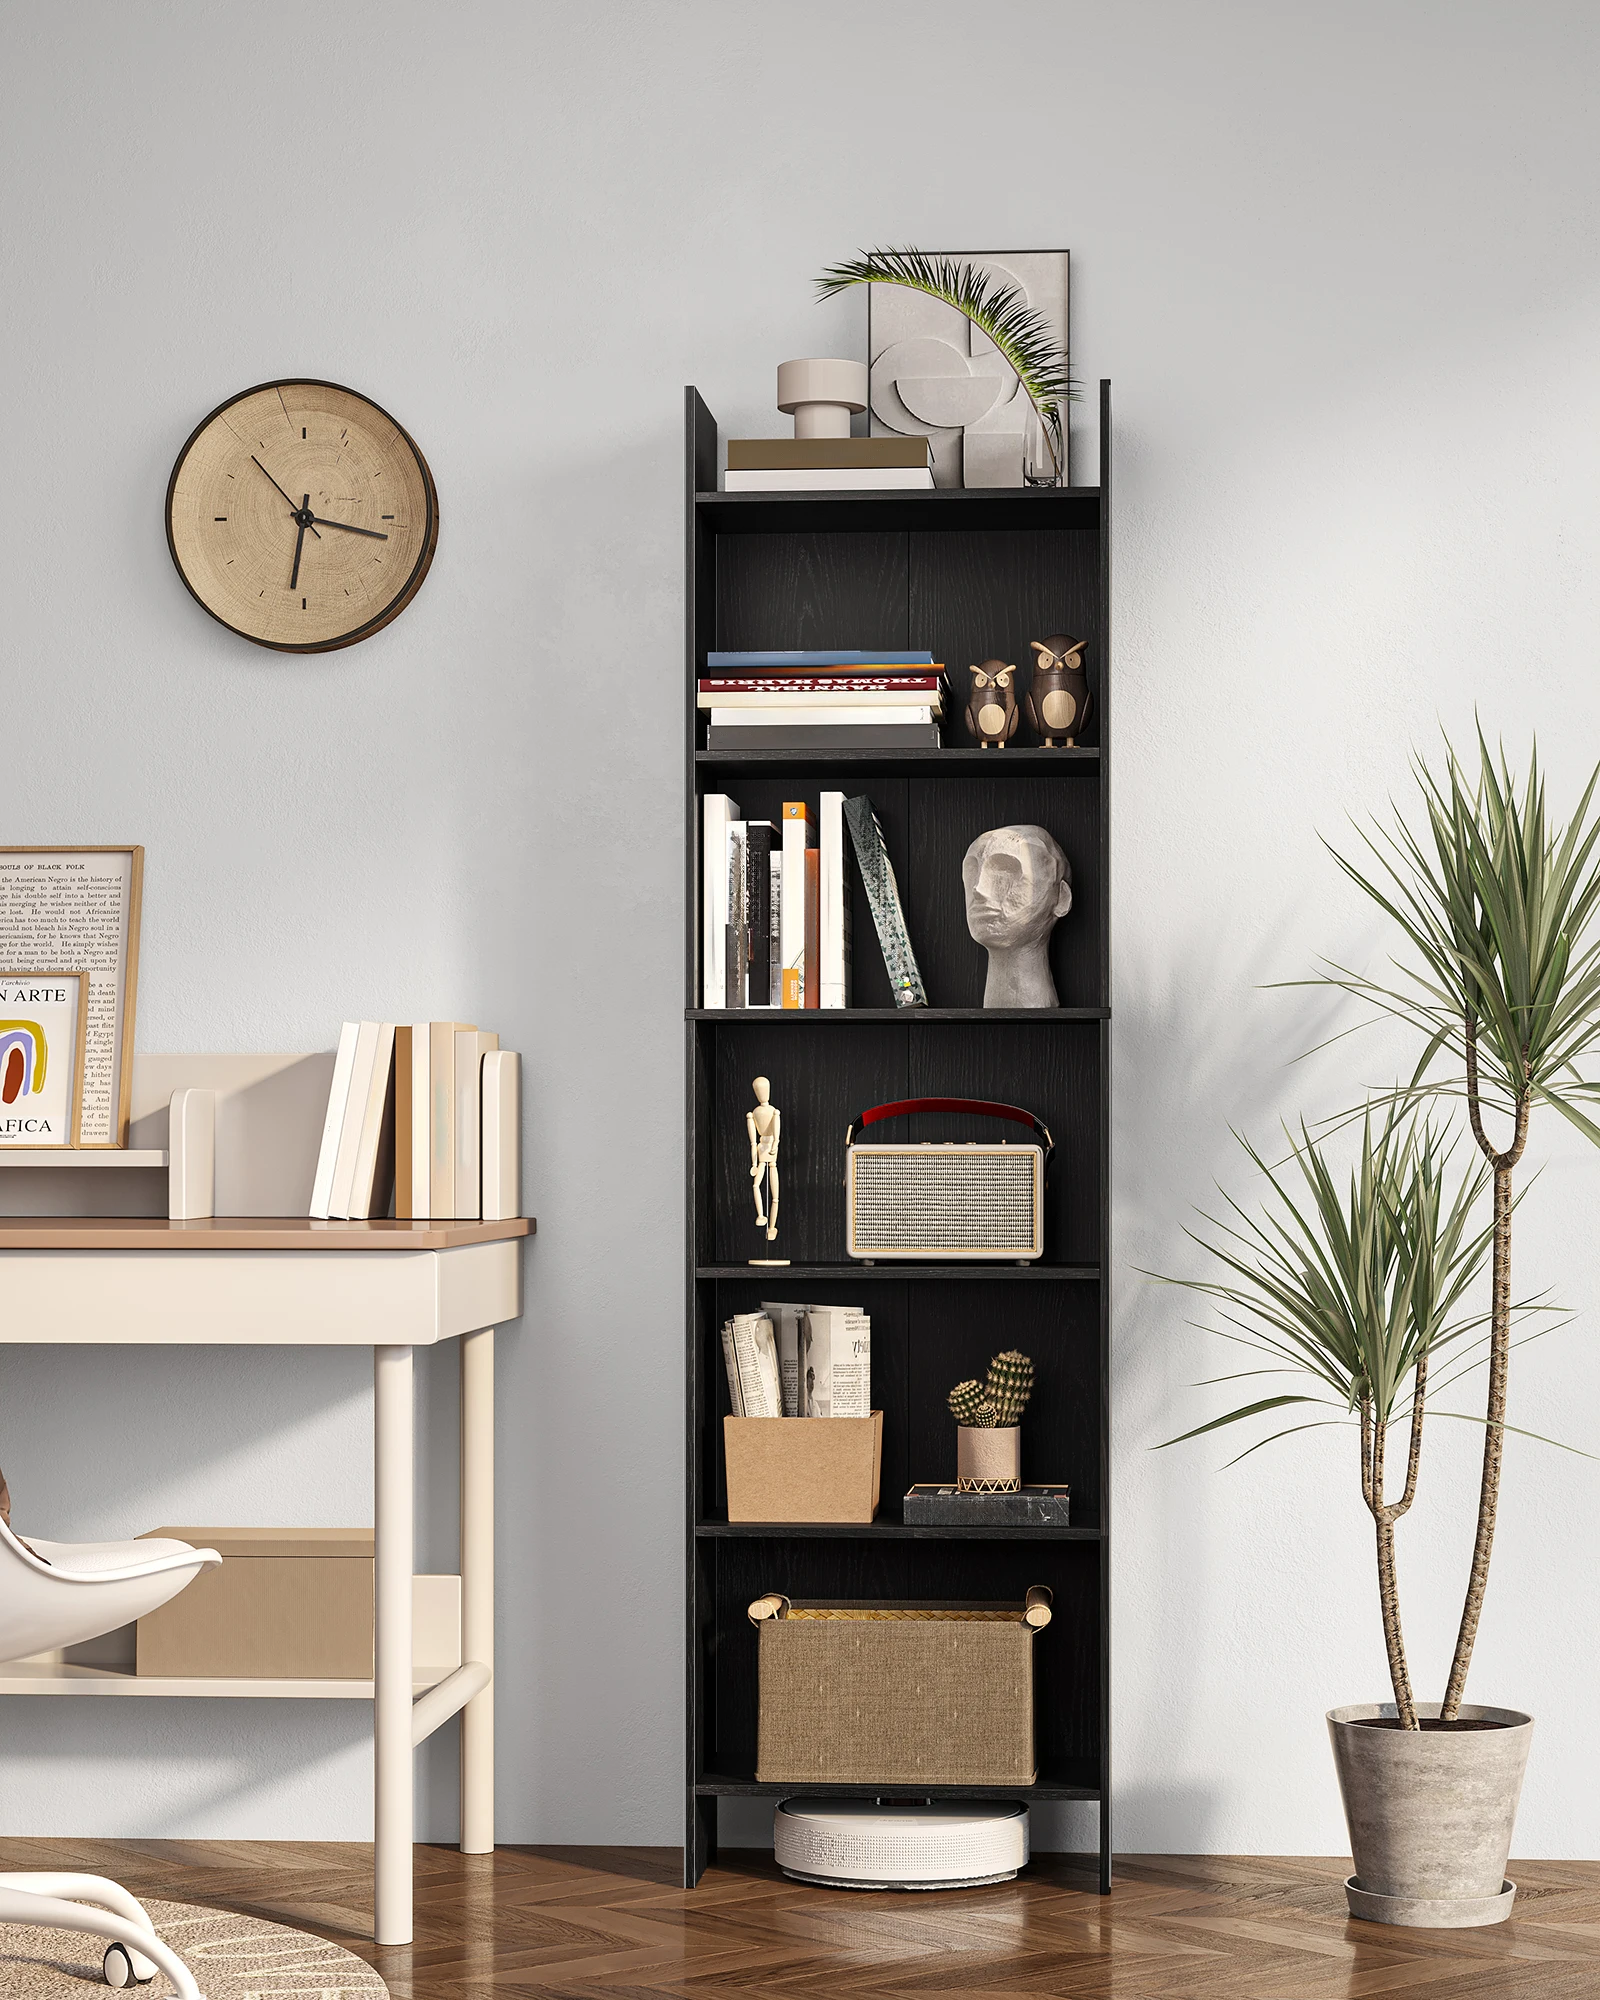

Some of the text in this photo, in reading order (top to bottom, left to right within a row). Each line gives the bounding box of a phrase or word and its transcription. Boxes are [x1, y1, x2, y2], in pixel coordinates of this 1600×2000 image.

[90, 876, 114, 884] history
[14, 989, 66, 1002] ARTE
[96, 1063, 112, 1071] days
